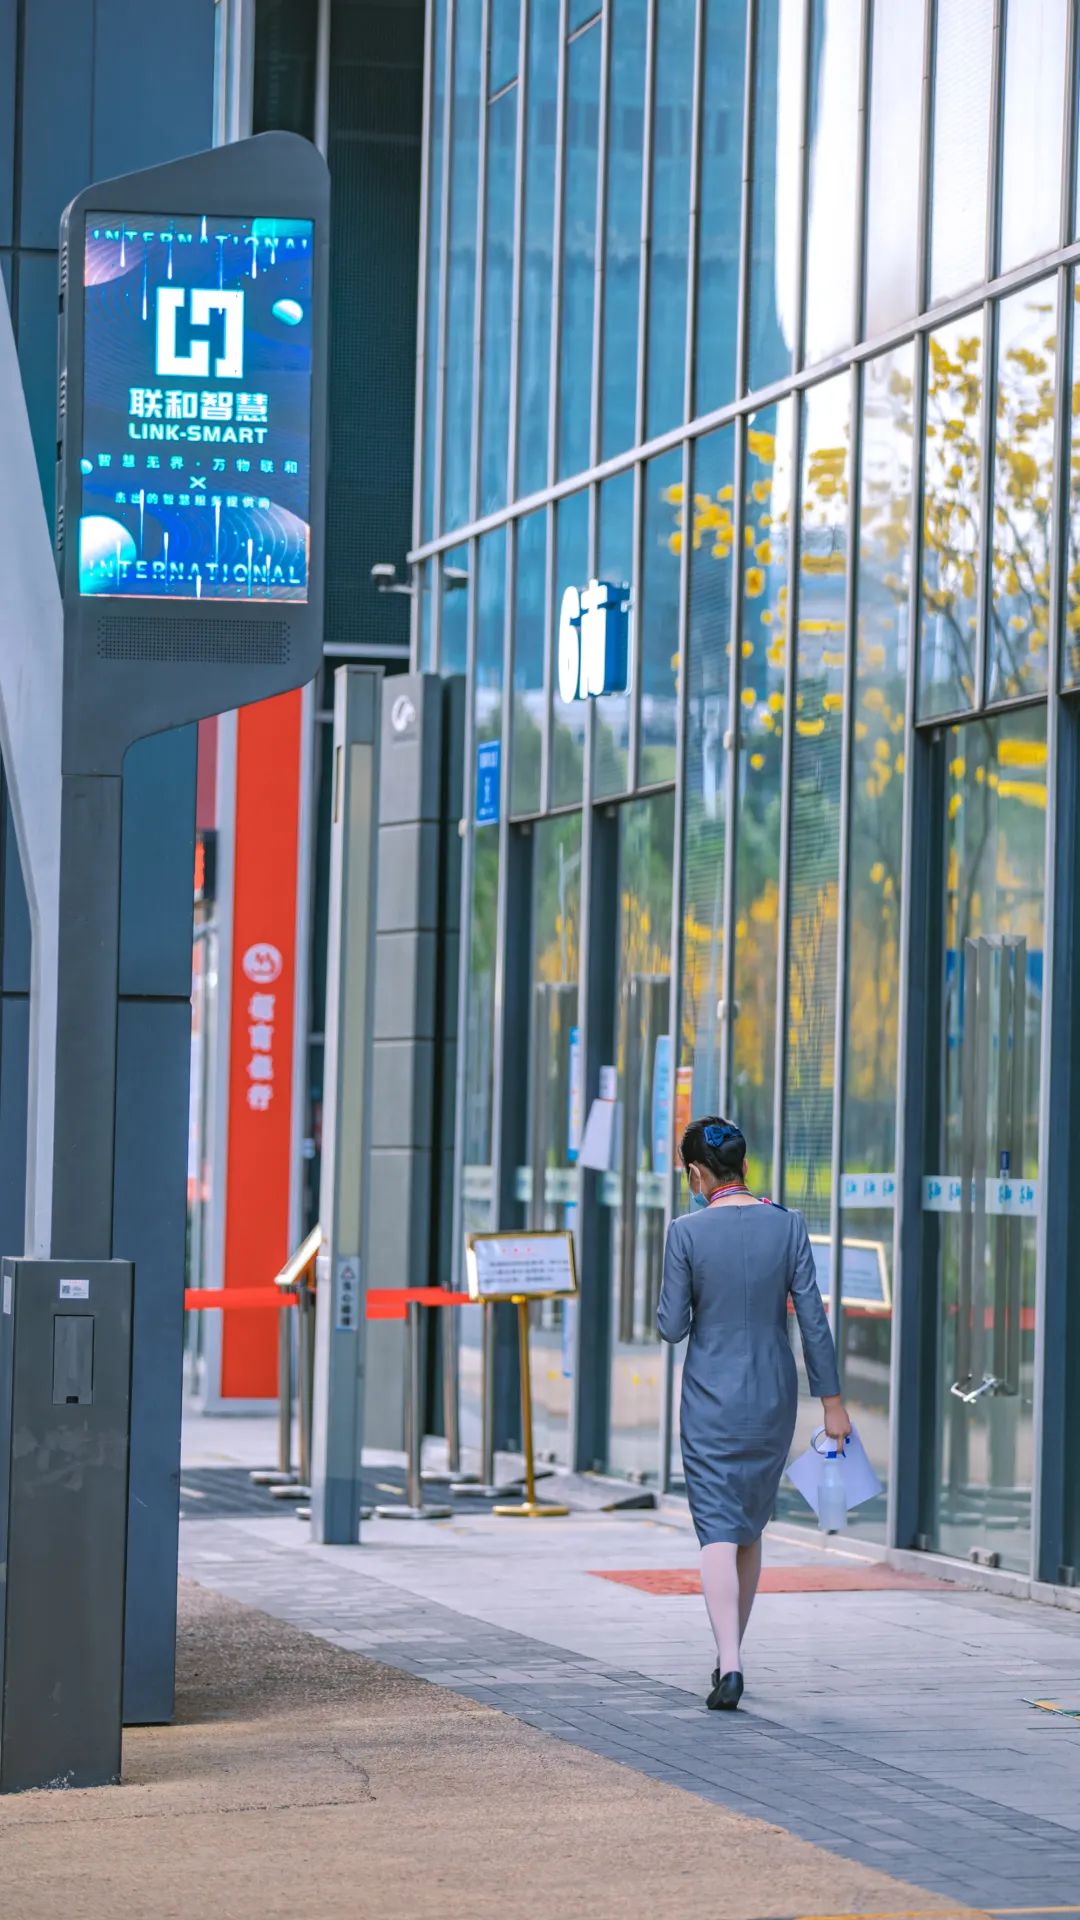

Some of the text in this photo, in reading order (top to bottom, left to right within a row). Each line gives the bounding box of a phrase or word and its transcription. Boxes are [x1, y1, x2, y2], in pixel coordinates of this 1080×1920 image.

[129, 388, 268, 423] 联和智慧
[128, 423, 269, 444] LINK-SMART
[89, 560, 301, 584] INTERNATIONAL
